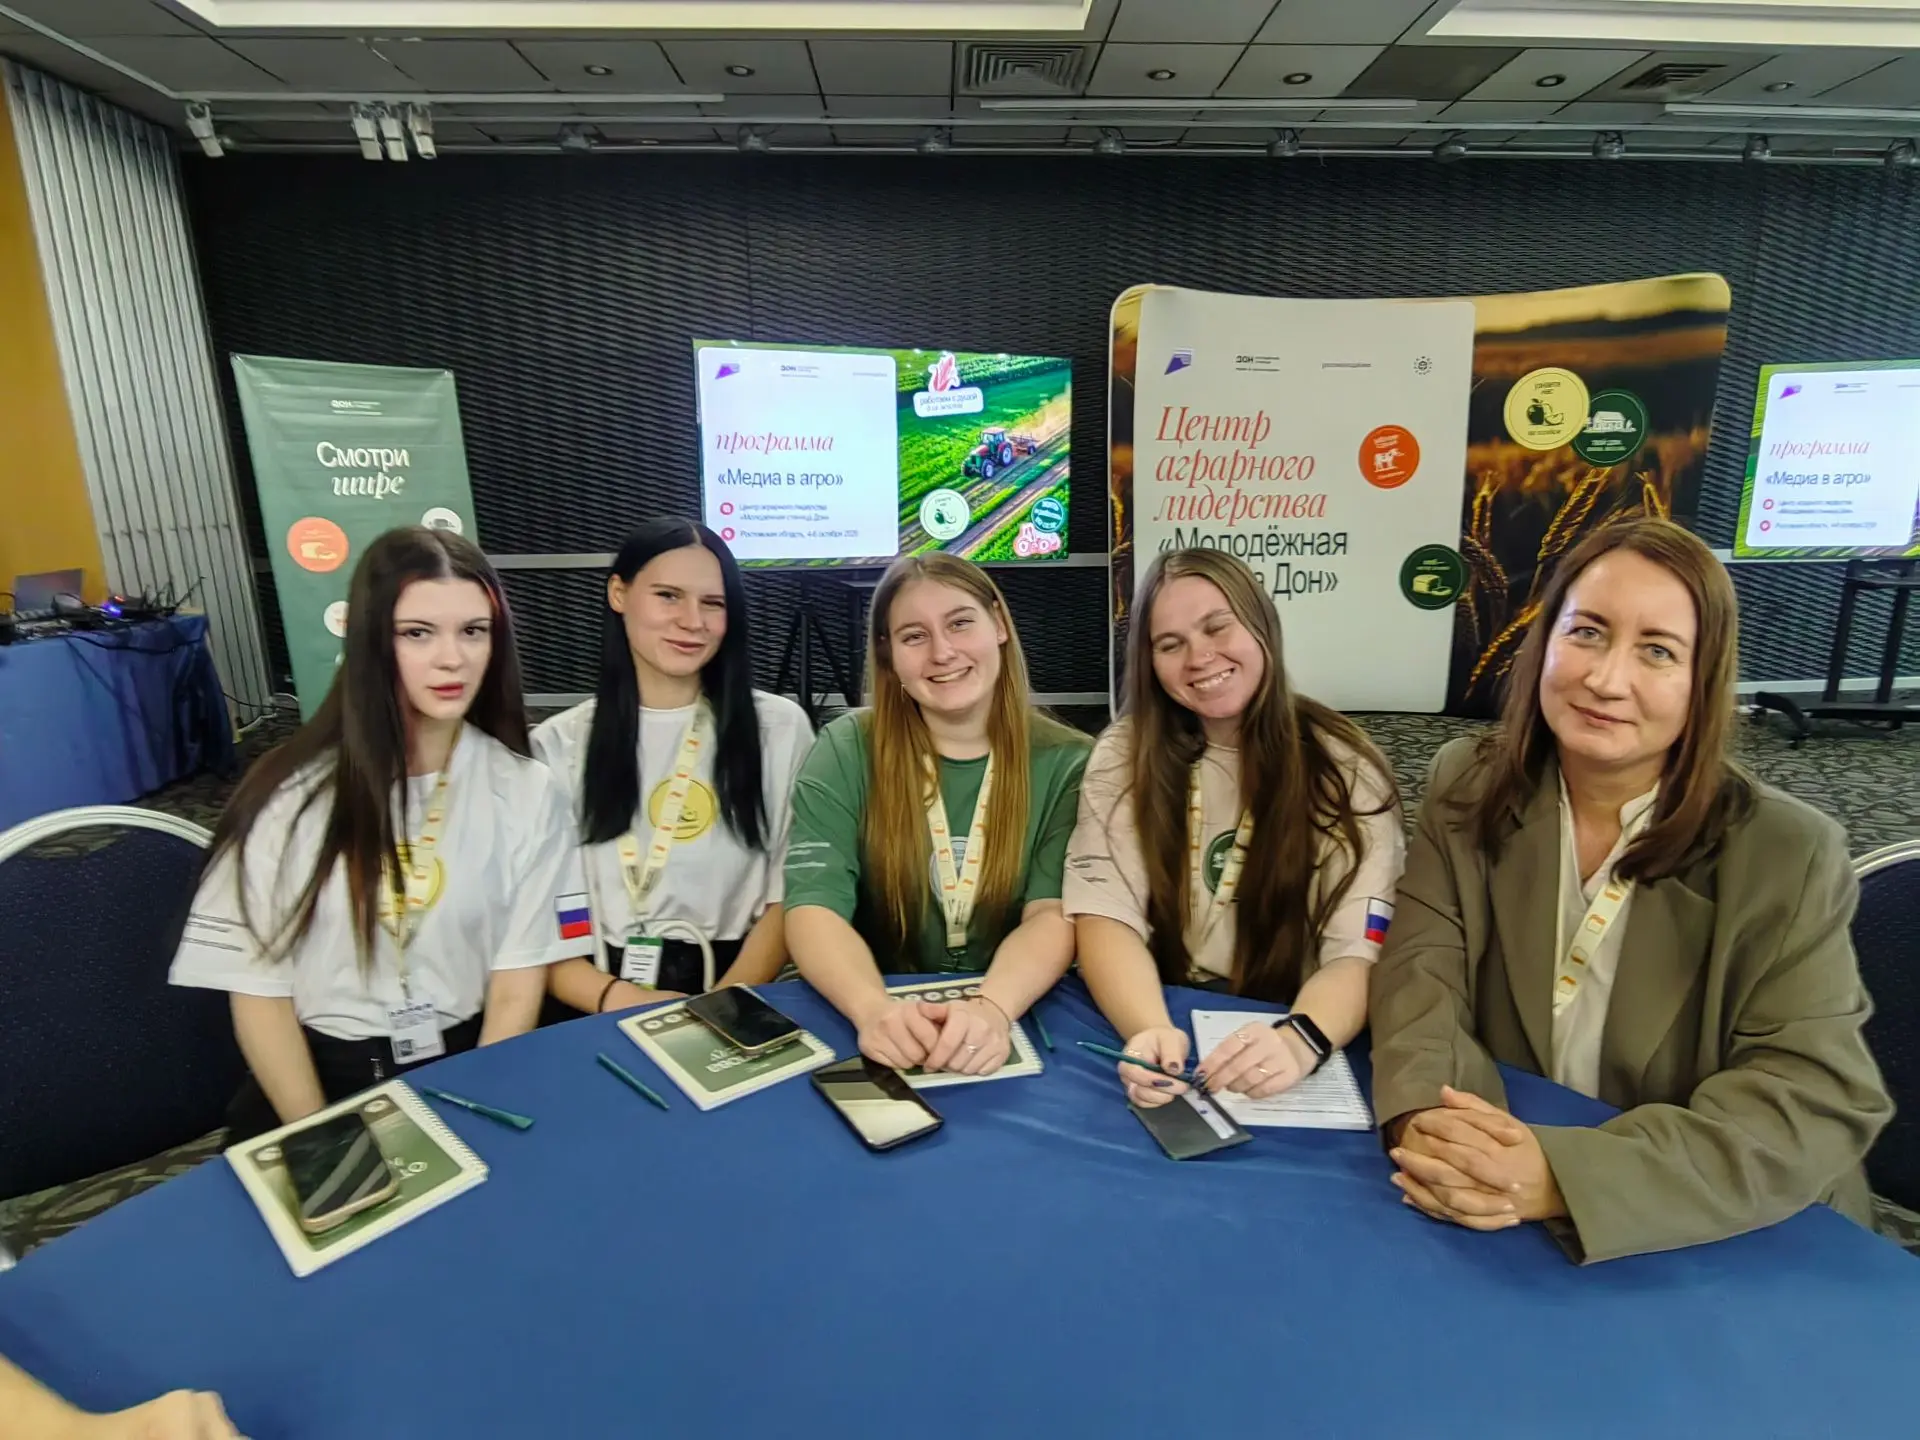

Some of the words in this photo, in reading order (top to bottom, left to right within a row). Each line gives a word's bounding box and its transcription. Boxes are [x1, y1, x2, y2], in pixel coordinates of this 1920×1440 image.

[1155, 406, 1271, 449] Центр
[316, 441, 410, 472] Смотри
[716, 432, 835, 455] программа
[1769, 439, 1871, 459] программа
[717, 468, 782, 488] «Медиа
[786, 475, 795, 485] в
[800, 473, 844, 489] агро»
[1155, 449, 1316, 488] аграрного
[1766, 471, 1818, 487] «Медиа
[1821, 474, 1830, 485] в
[1833, 473, 1871, 487] агро»
[331, 472, 405, 500] шире
[1153, 485, 1327, 527] лидерства
[1158, 525, 1348, 563] «Молодёжная
[1271, 562, 1339, 601] Дон»
